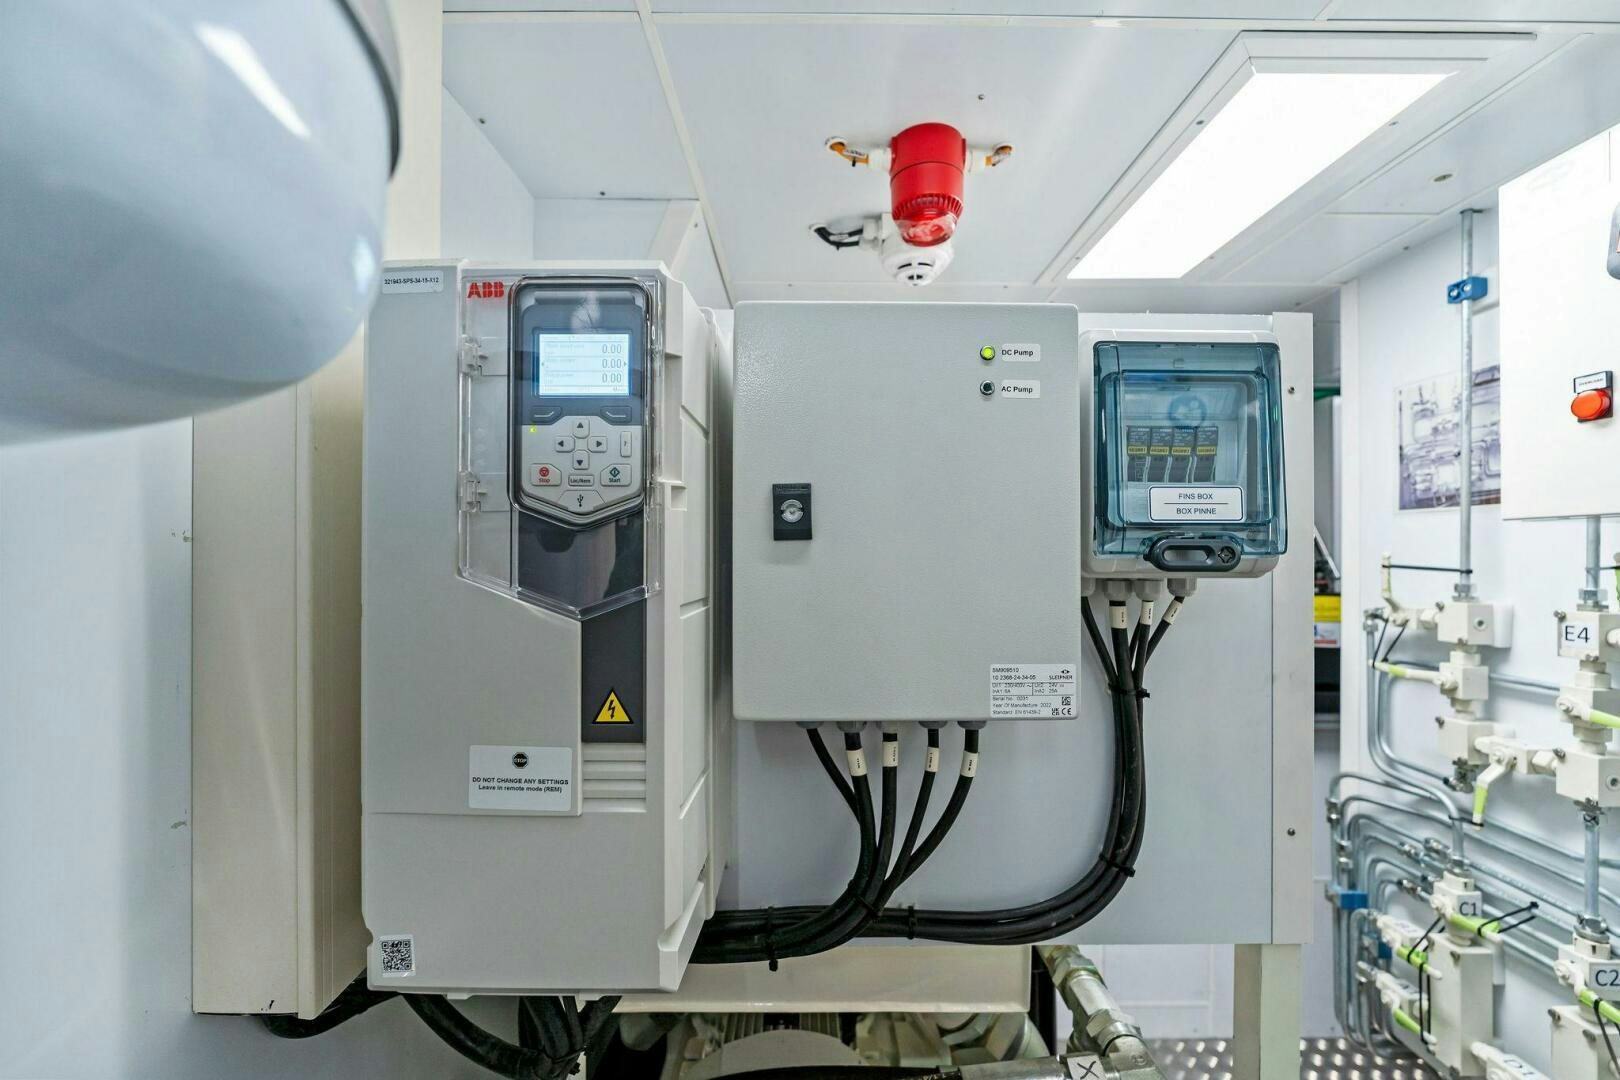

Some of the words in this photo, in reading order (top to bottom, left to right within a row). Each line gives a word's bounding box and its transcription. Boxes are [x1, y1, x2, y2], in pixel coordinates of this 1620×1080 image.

[467, 281, 504, 299] ABB
[602, 344, 622, 354] 0.00
[1013, 349, 1034, 357] Pump
[602, 359, 622, 369] 0.00
[602, 373, 622, 383] 0.00
[1013, 386, 1033, 394] Pump
[1193, 507, 1217, 515] PINNE
[1564, 626, 1590, 644] E4
[543, 786, 562, 794] (REM)
[1459, 901, 1478, 916] C1
[1595, 969, 1620, 987] C2
